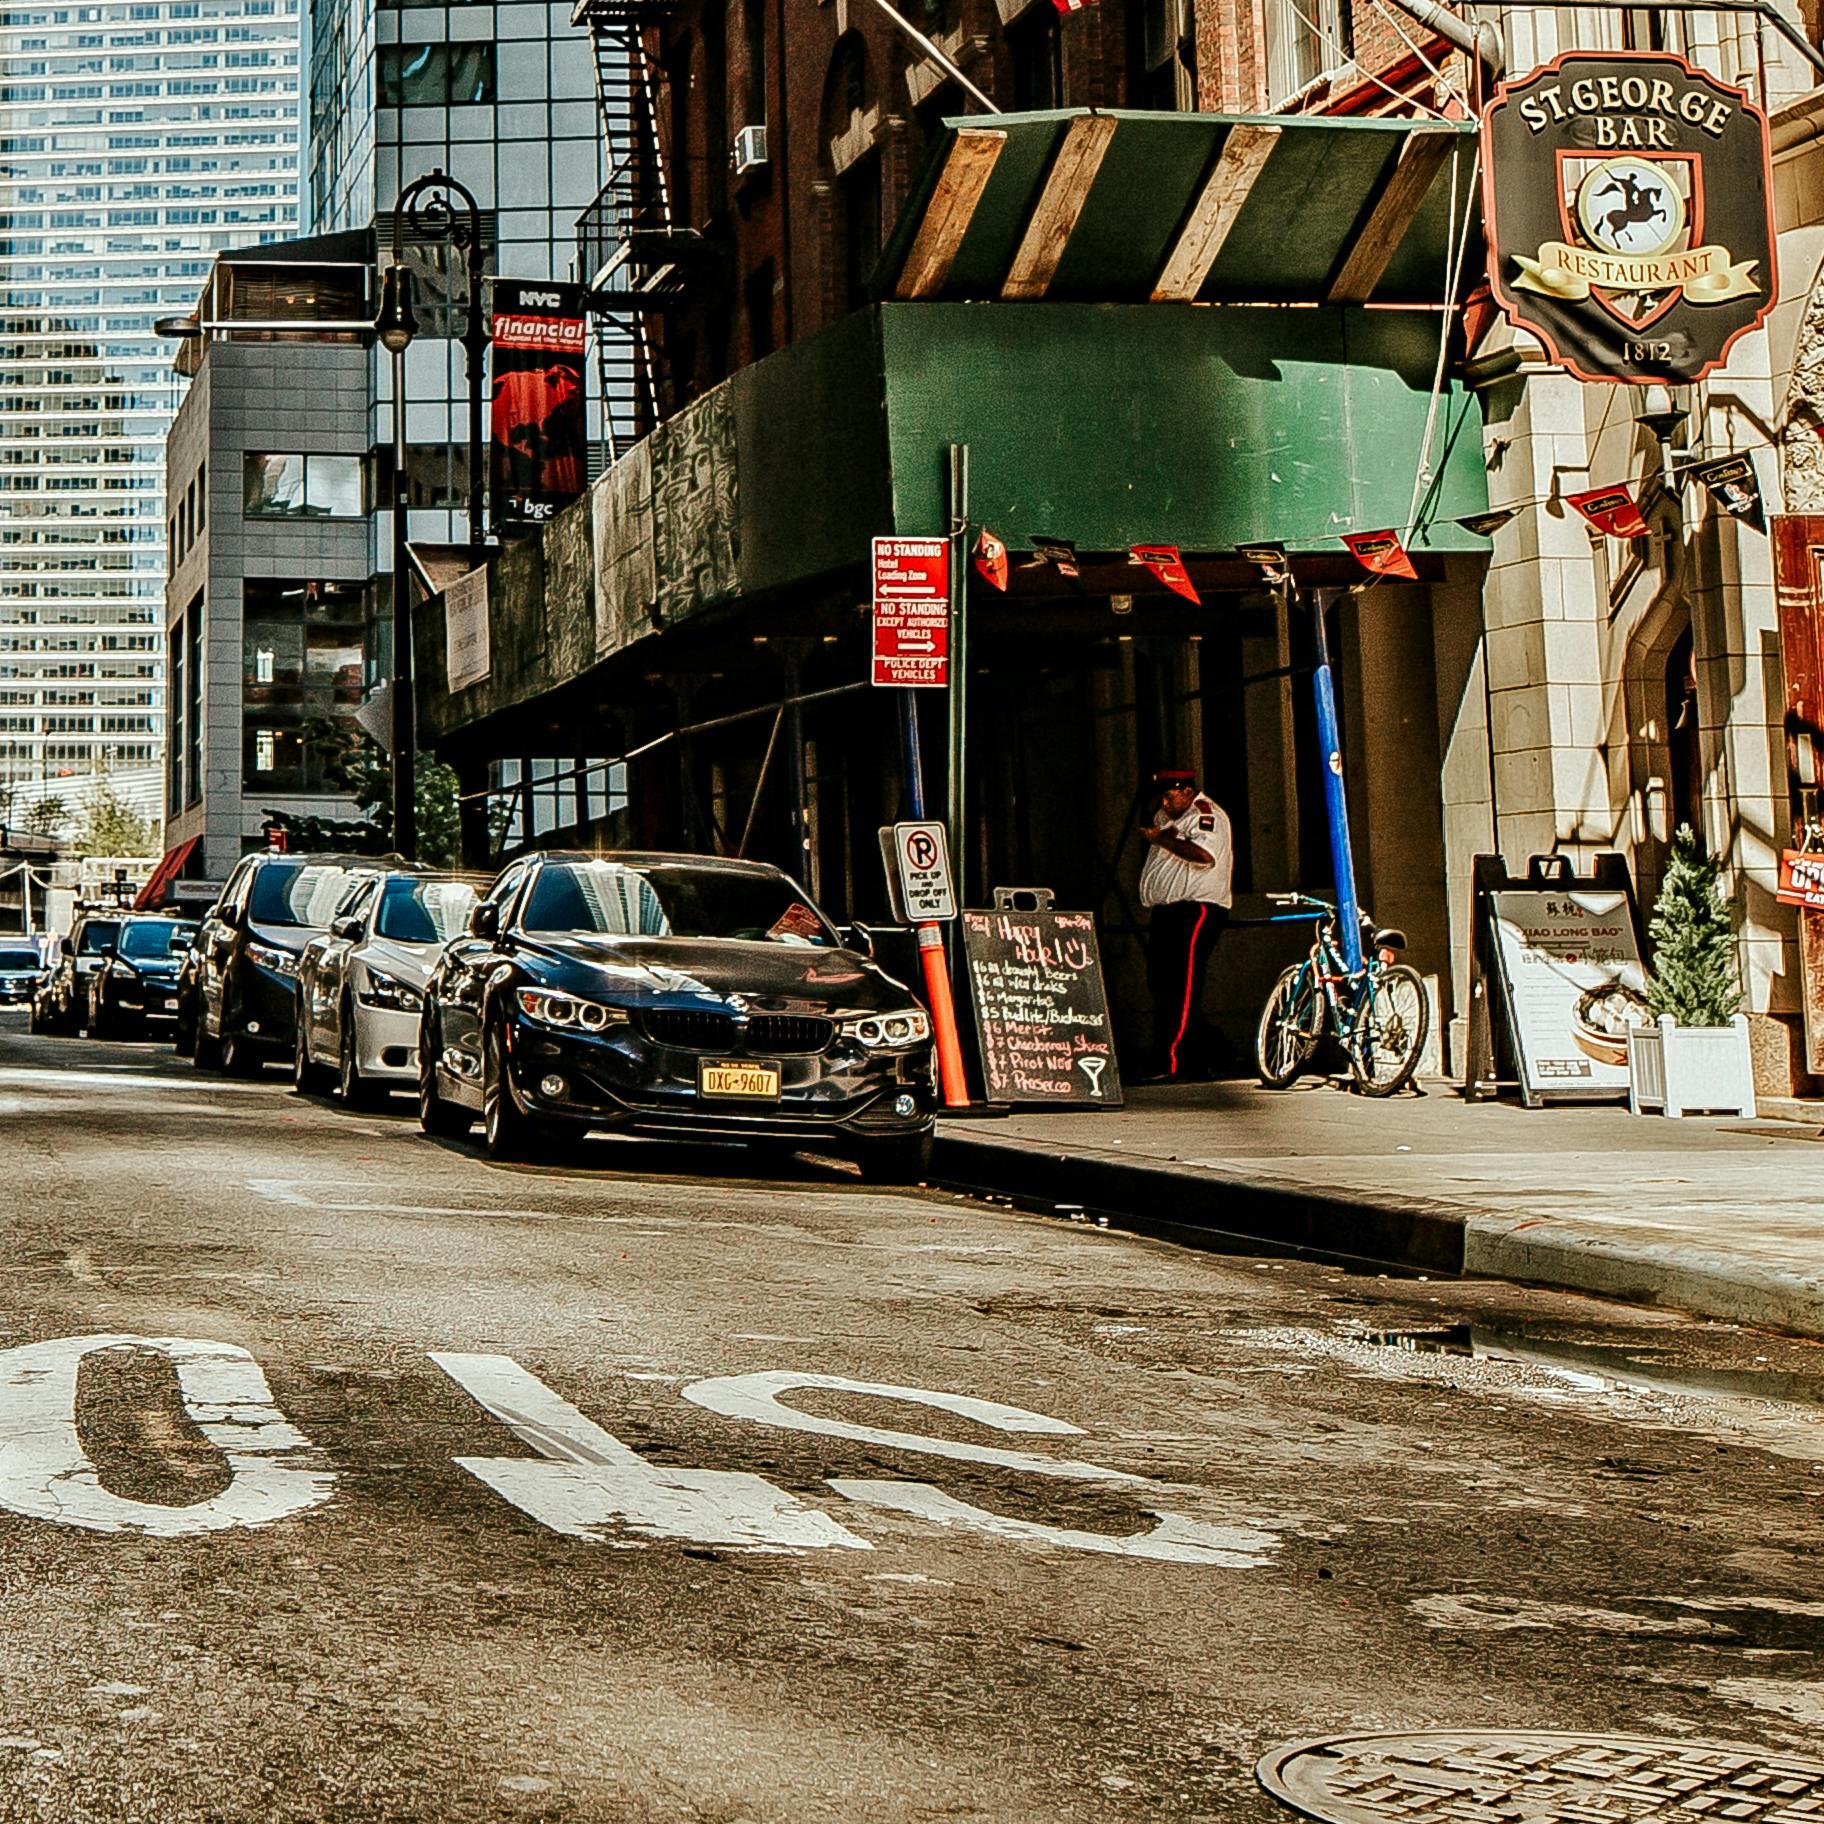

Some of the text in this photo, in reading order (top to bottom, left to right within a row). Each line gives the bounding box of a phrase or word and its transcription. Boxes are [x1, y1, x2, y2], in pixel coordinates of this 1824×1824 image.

[1596, 116, 1674, 149] BAR
[1557, 250, 1713, 284] RESTAURANT
[519, 290, 561, 308] NYC
[495, 317, 584, 339] financial
[523, 498, 554, 519] bgc
[877, 544, 942, 558] NO STANDING
[877, 559, 898, 568] Hotel
[877, 570, 927, 582] Loading Zone
[880, 603, 947, 616] NO STANDING
[876, 617, 904, 627] EXCEPT
[897, 629, 932, 639] VEHICLES
[891, 669, 936, 680] VEHICLES
[909, 871, 941, 880] PICK UP
[1791, 865, 1824, 890] OP
[908, 888, 947, 898] DROP OFF
[919, 899, 940, 909] ONLY
[1553, 928, 1589, 937] LONG
